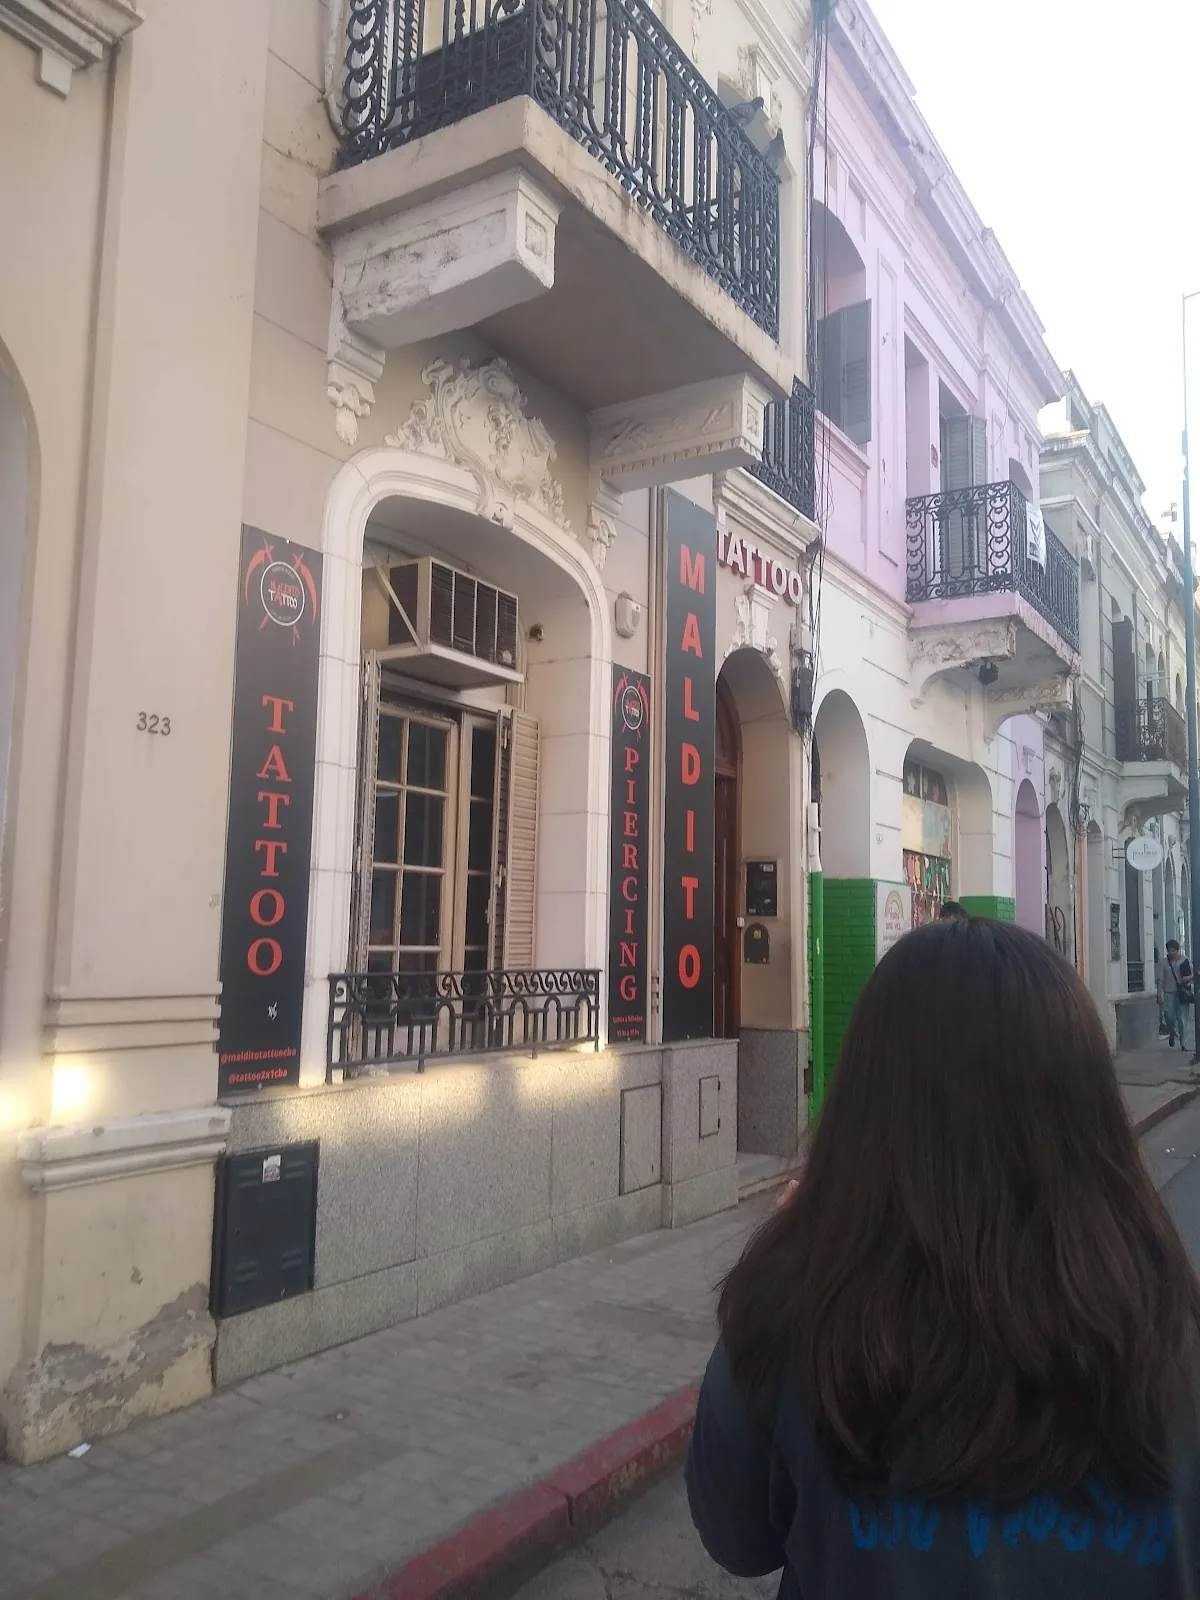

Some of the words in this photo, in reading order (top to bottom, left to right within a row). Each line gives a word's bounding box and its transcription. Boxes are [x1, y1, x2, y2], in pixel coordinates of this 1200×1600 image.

[268, 588, 298, 609] TATTOO
[716, 528, 803, 606] TATTOO
[136, 711, 171, 736] 323
[678, 543, 705, 989] MALDITO
[247, 695, 294, 976] TATTOO
[619, 746, 640, 1001] PIERCING
